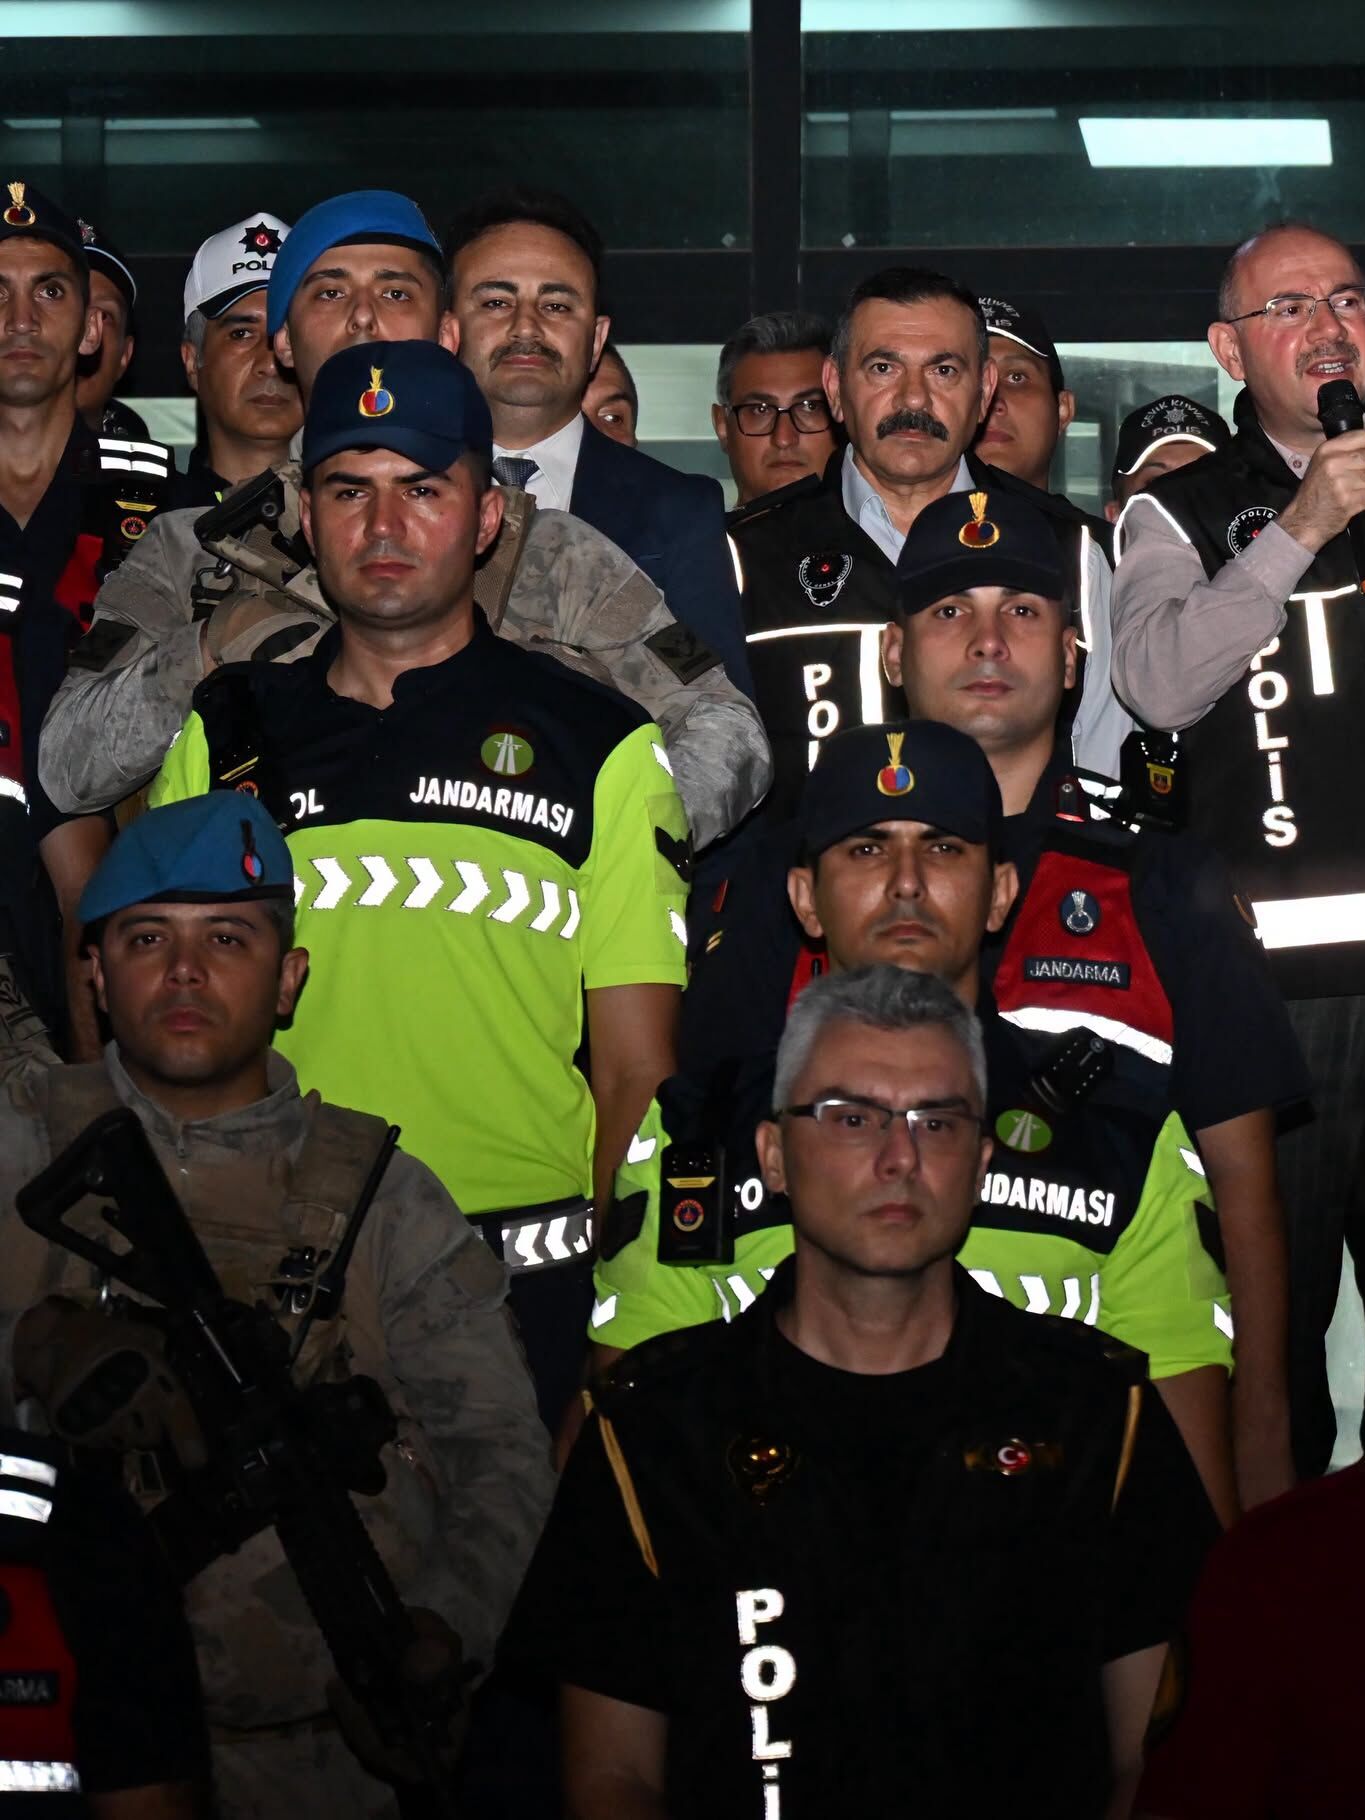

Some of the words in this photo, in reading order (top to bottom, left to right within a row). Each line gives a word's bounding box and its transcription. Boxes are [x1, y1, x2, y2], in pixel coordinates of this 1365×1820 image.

[232, 260, 273, 275] POL
[409, 776, 575, 838] JANDARMASI
[1029, 961, 1121, 983] JANDARMA
